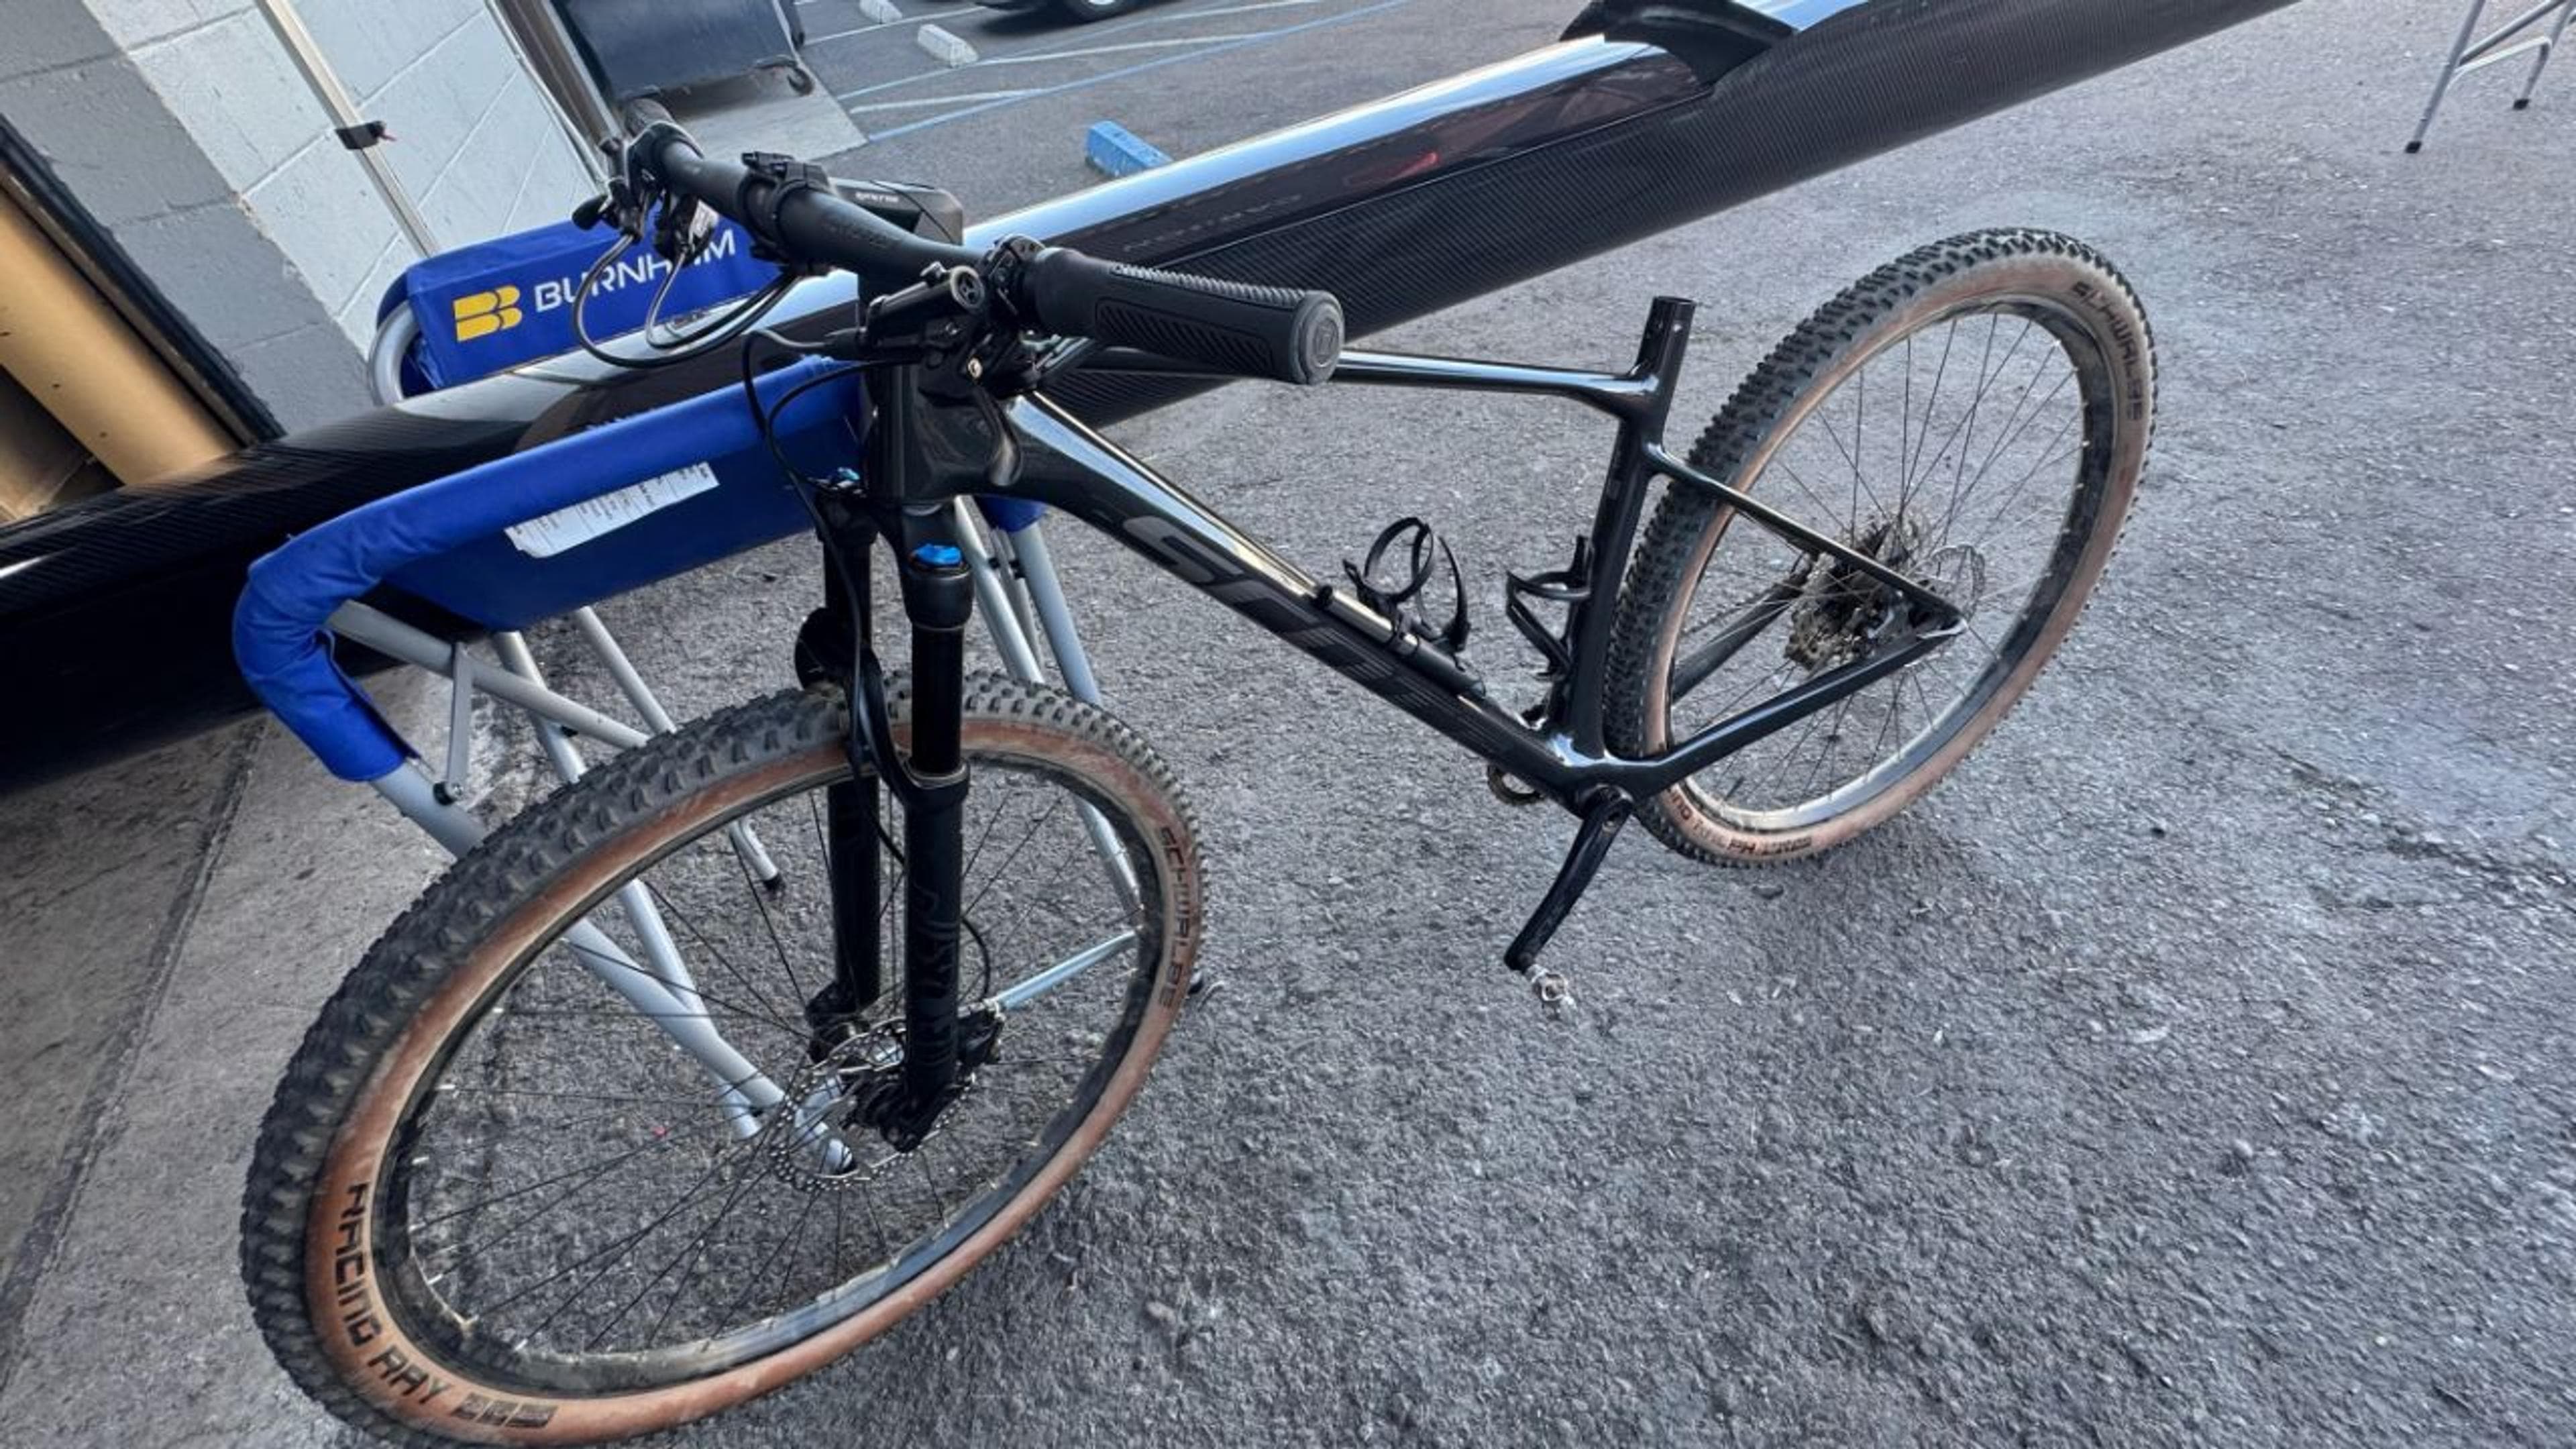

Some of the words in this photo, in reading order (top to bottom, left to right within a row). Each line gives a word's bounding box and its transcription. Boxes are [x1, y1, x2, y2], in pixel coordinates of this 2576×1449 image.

[535, 229, 736, 311] BURNHM
[1159, 826, 1191, 1008] SCHWALBE
[334, 1181, 382, 1346] RACING
[368, 1344, 451, 1404] RAY
